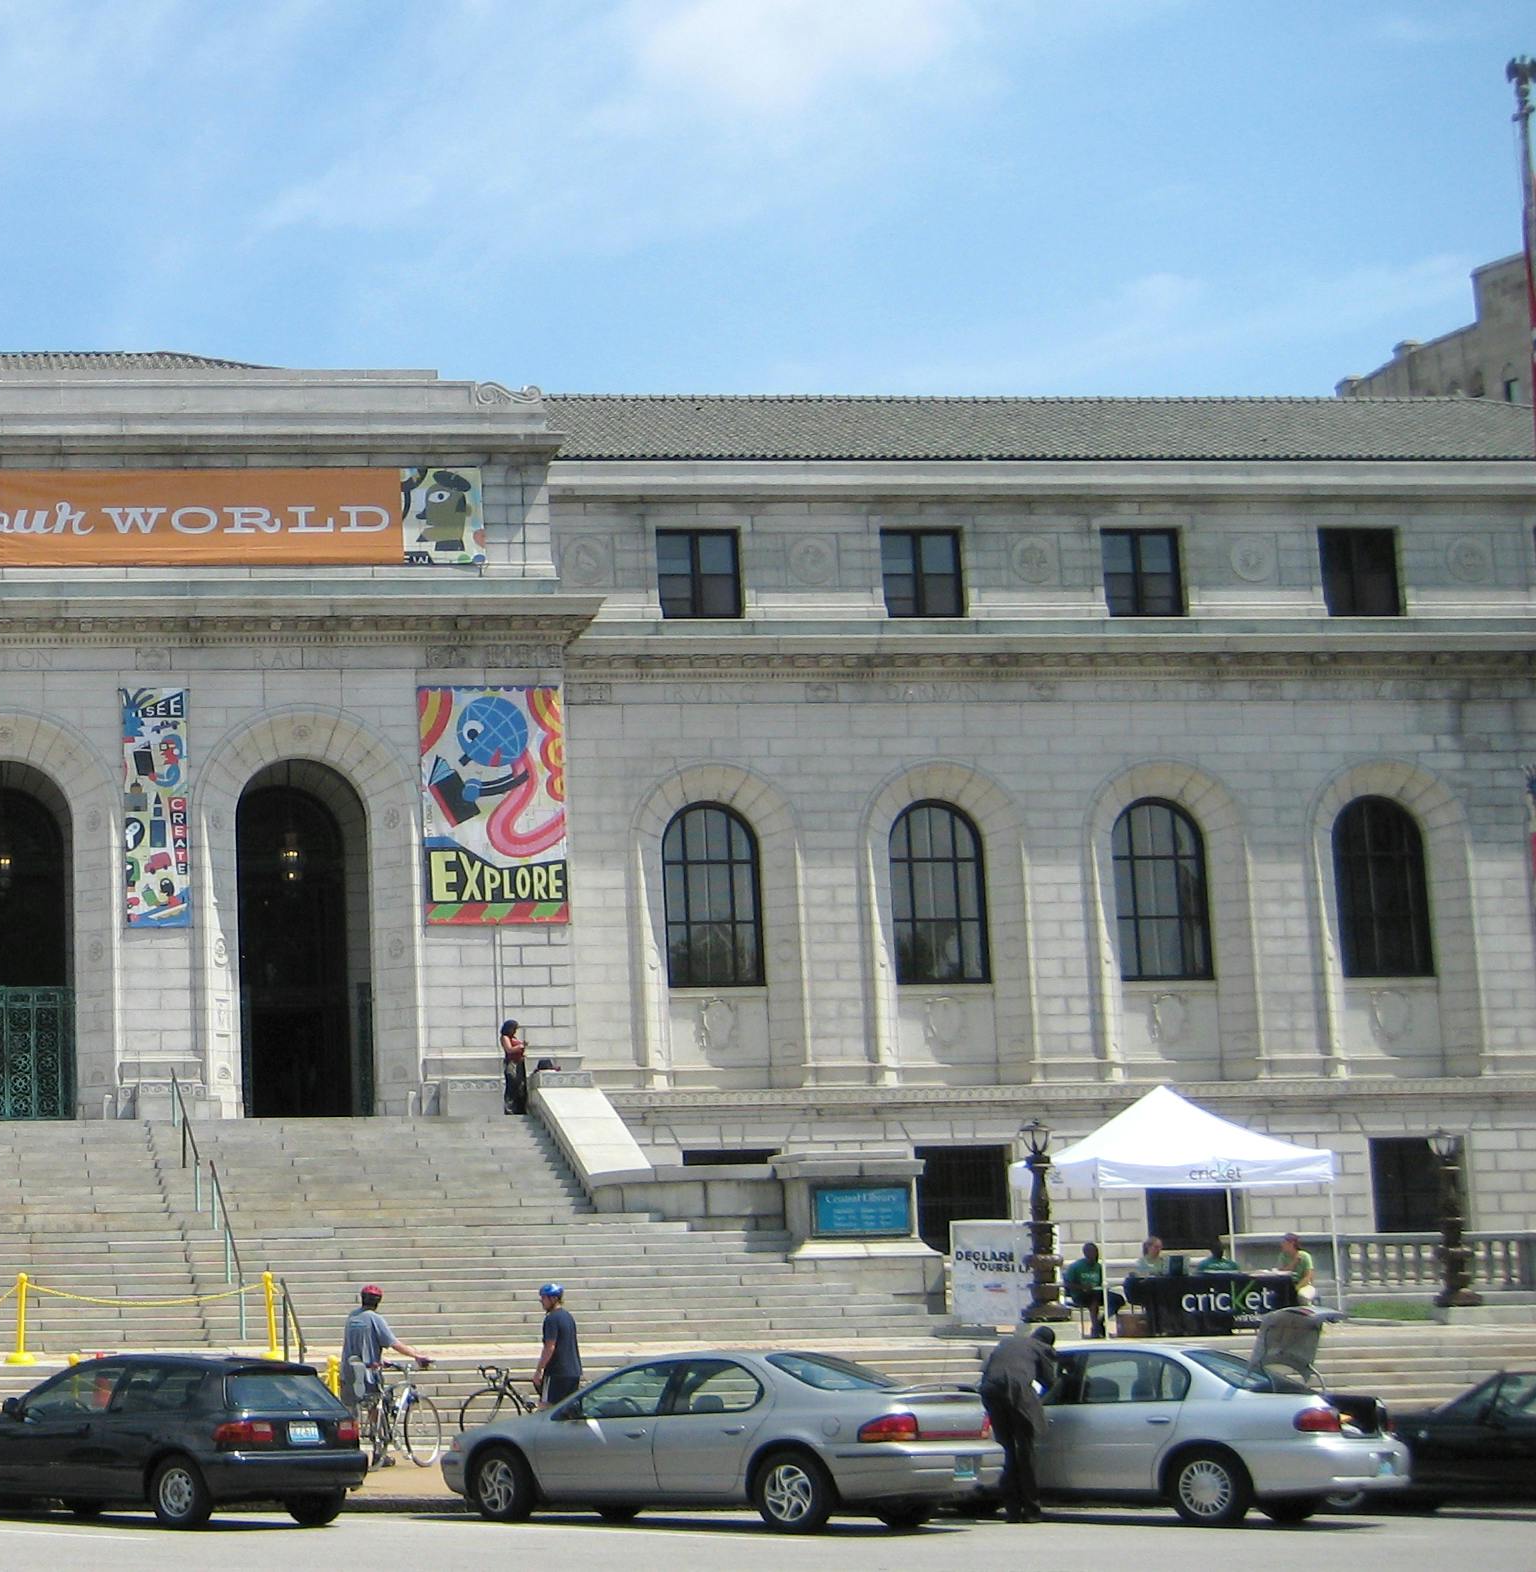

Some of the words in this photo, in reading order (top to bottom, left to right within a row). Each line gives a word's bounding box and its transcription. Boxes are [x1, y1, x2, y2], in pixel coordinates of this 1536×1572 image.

[102, 505, 390, 534] WORLD
[404, 555, 430, 565] EW
[253, 648, 350, 669] RACINE
[146, 696, 182, 717] SEE
[171, 799, 187, 874] CREATE
[430, 851, 562, 902] EXPLORE
